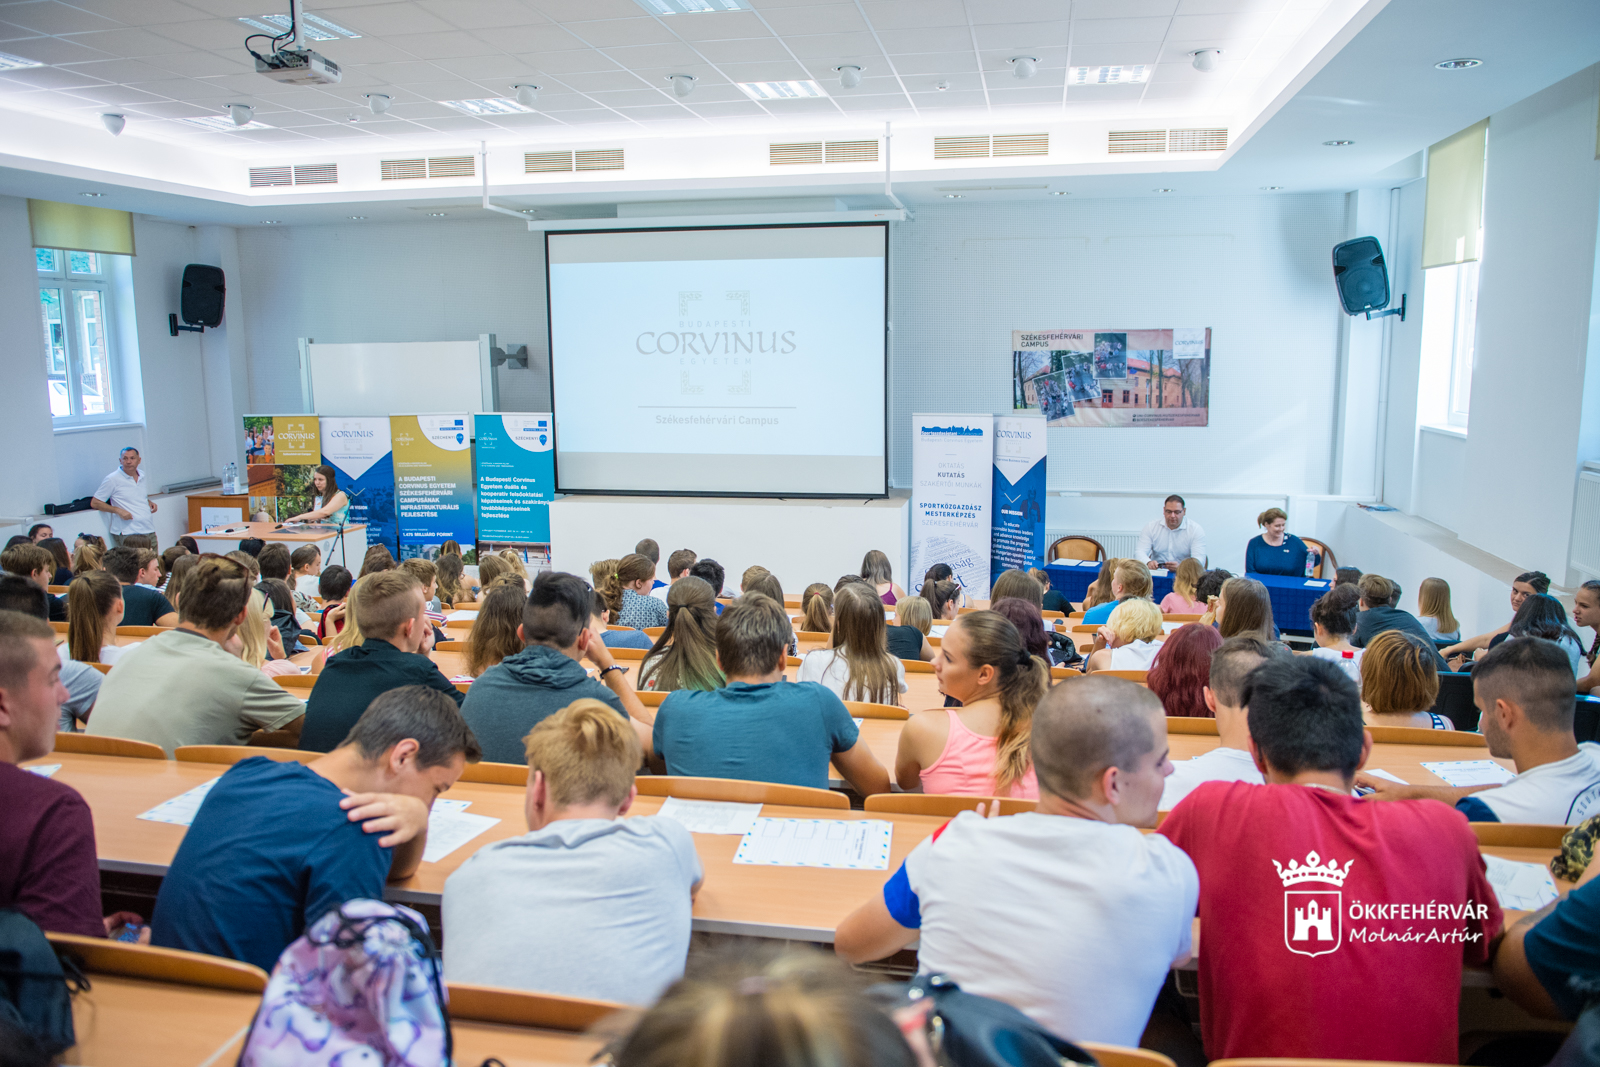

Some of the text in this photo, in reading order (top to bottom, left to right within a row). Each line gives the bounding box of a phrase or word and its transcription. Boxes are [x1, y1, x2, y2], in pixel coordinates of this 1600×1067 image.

[678, 320, 752, 328] BUDAPESTI
[1020, 332, 1084, 341] SZÉKESFEHÉRVÁRI
[635, 330, 797, 356] CORVINUS
[679, 357, 752, 365] EGYETEM
[655, 414, 779, 427] Székesfehérvári Campus
[277, 432, 316, 440] CORVINUS
[330, 430, 374, 438] CORVINUS
[995, 430, 1032, 440] CORVINUS
[937, 471, 966, 479] KUTATÁS
[955, 481, 983, 489] MUNKÁK
[919, 502, 982, 512] SPORTKÖZGAZDÁSZ
[924, 510, 976, 519] MESTERKÉPZÉS
[921, 519, 979, 528] SZÉKESFEHÉRVÁR
